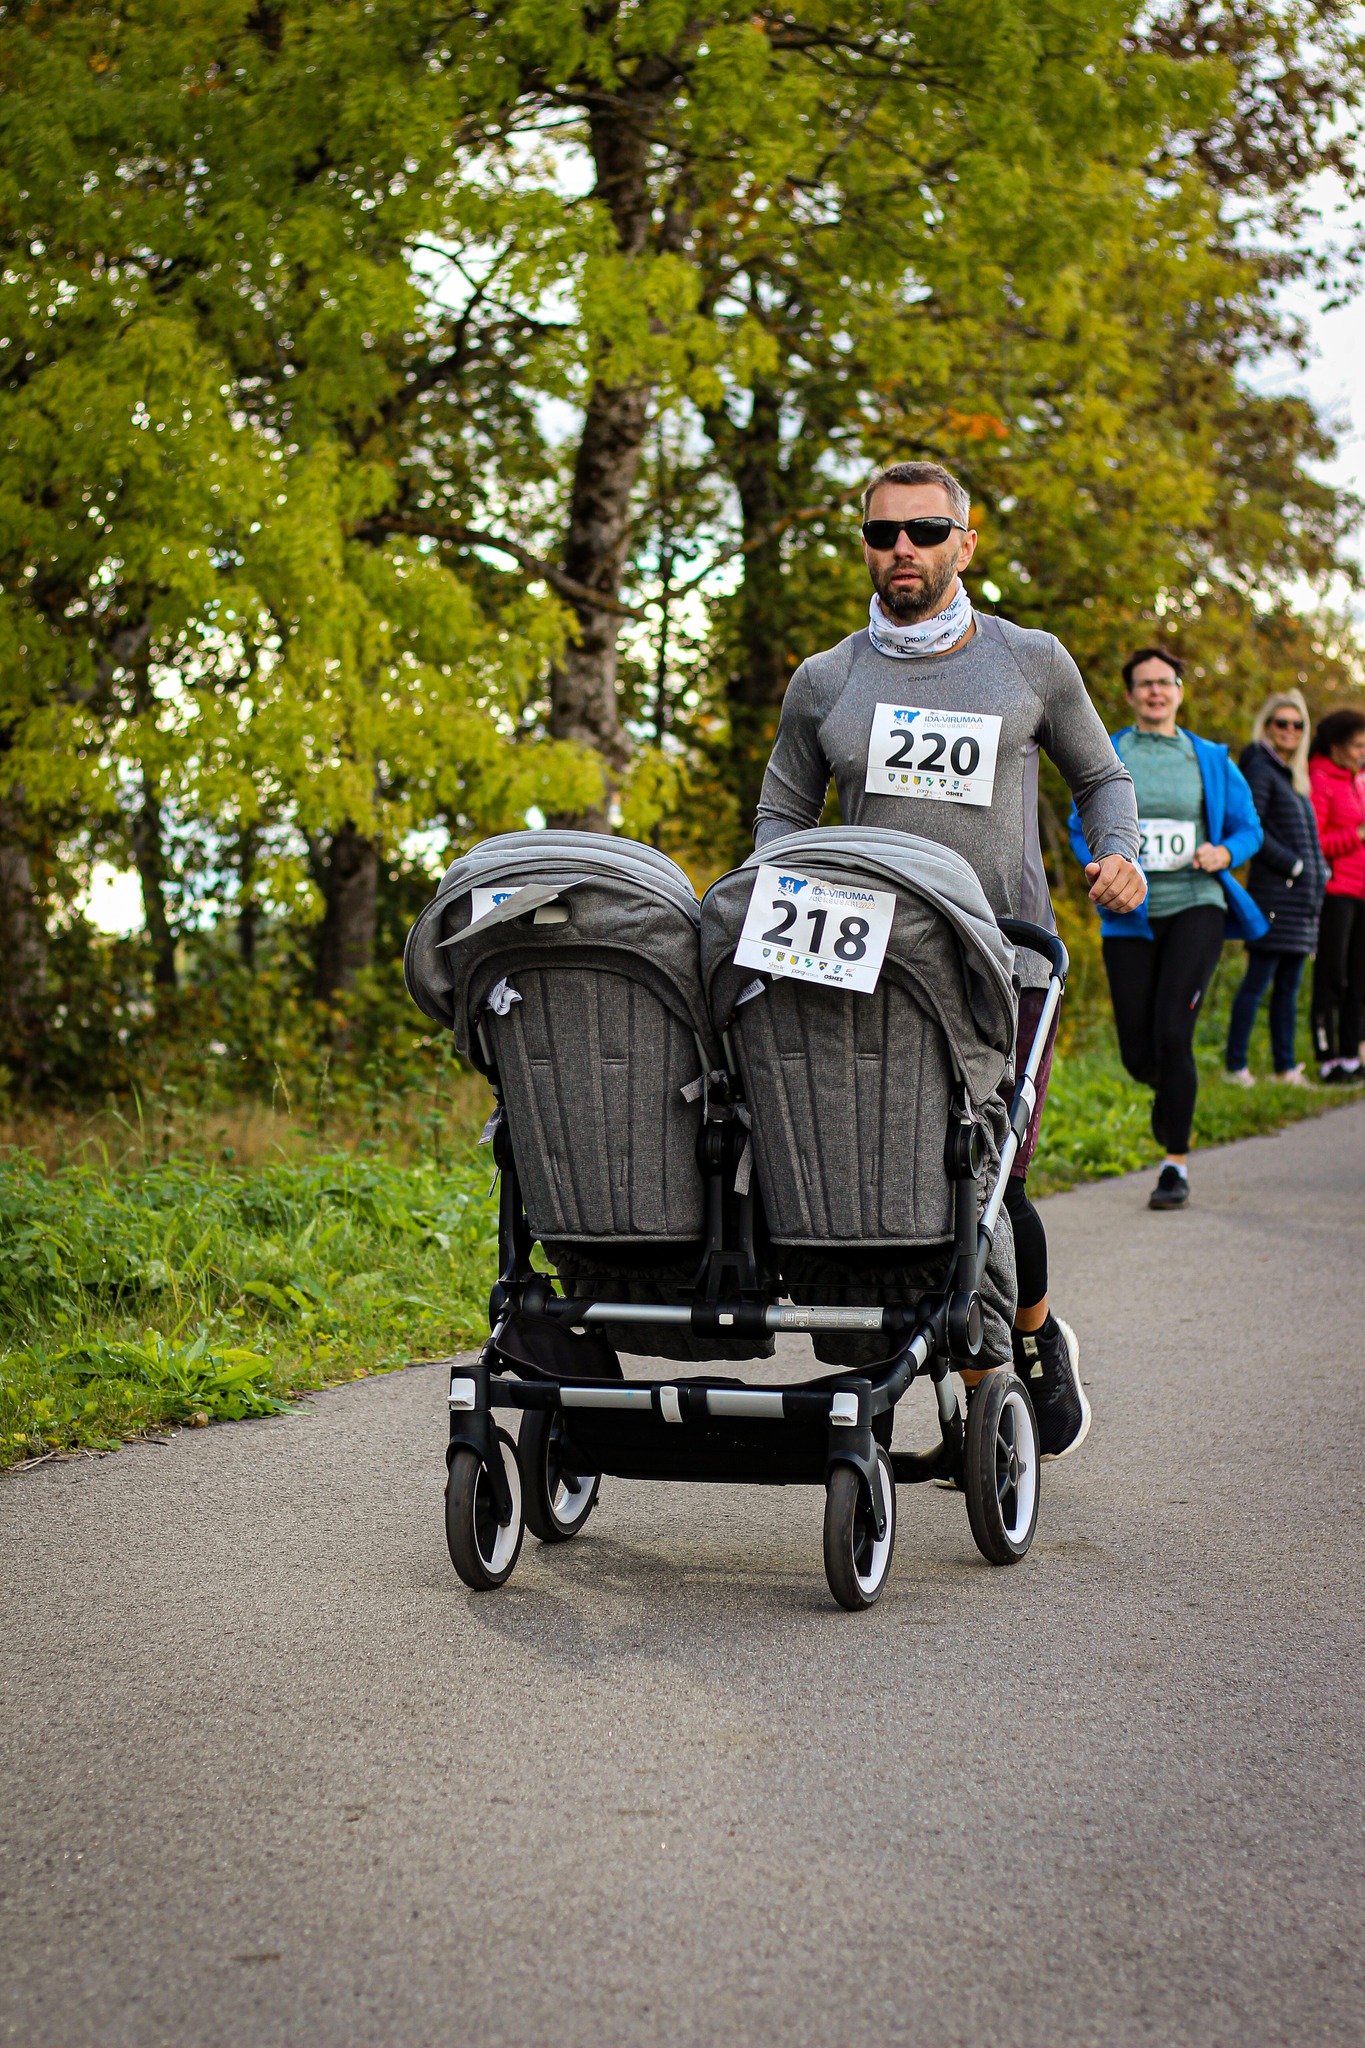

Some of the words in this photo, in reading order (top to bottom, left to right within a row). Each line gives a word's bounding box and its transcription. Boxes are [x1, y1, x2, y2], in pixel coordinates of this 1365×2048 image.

[924, 715, 983, 724] IDA-VIRUMAA
[885, 729, 981, 776] 220
[1139, 833, 1185, 855] 210
[811, 886, 875, 902] IDA-VIRUMAA
[858, 901, 876, 910] 2022
[761, 899, 870, 962] 218
